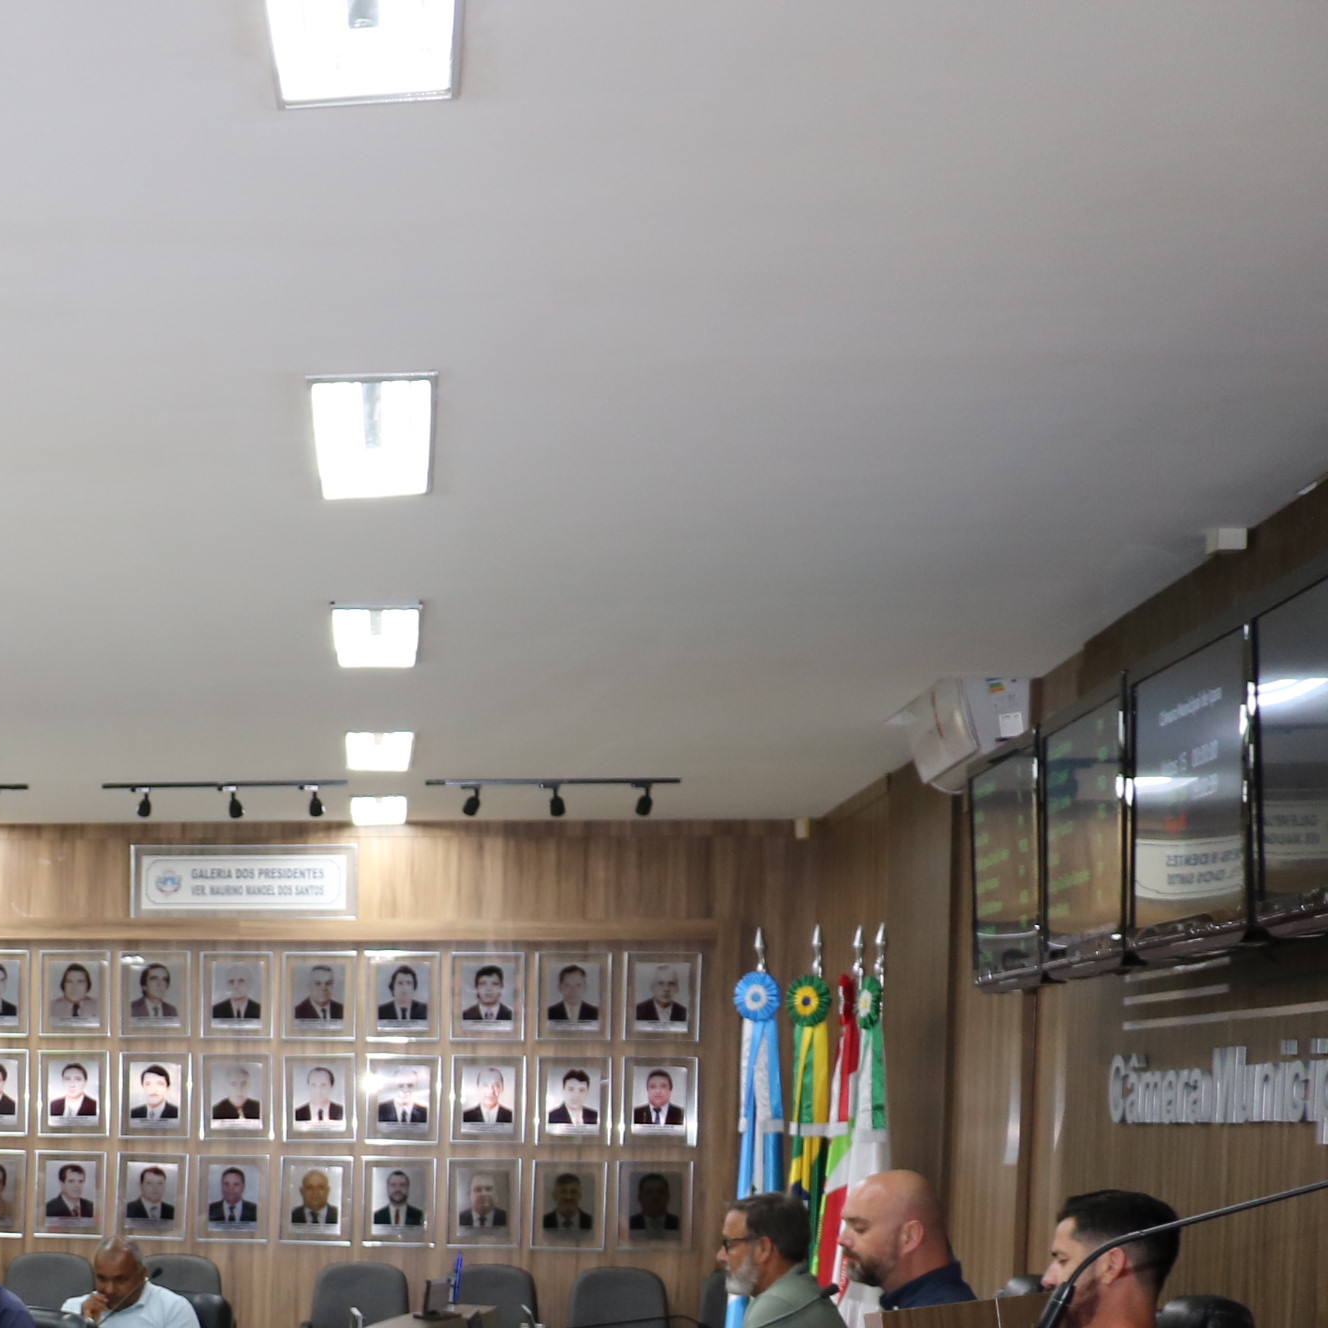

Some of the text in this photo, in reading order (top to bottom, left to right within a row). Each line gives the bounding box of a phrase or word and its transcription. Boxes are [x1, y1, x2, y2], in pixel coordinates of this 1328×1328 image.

[191, 868, 324, 879] GALERIA DOS PRESIDENTES
[245, 885, 275, 896] MANOEL
[277, 885, 293, 896] DOS
[294, 885, 324, 896] SANTOS
[1108, 1053, 1212, 1124] Câmara
